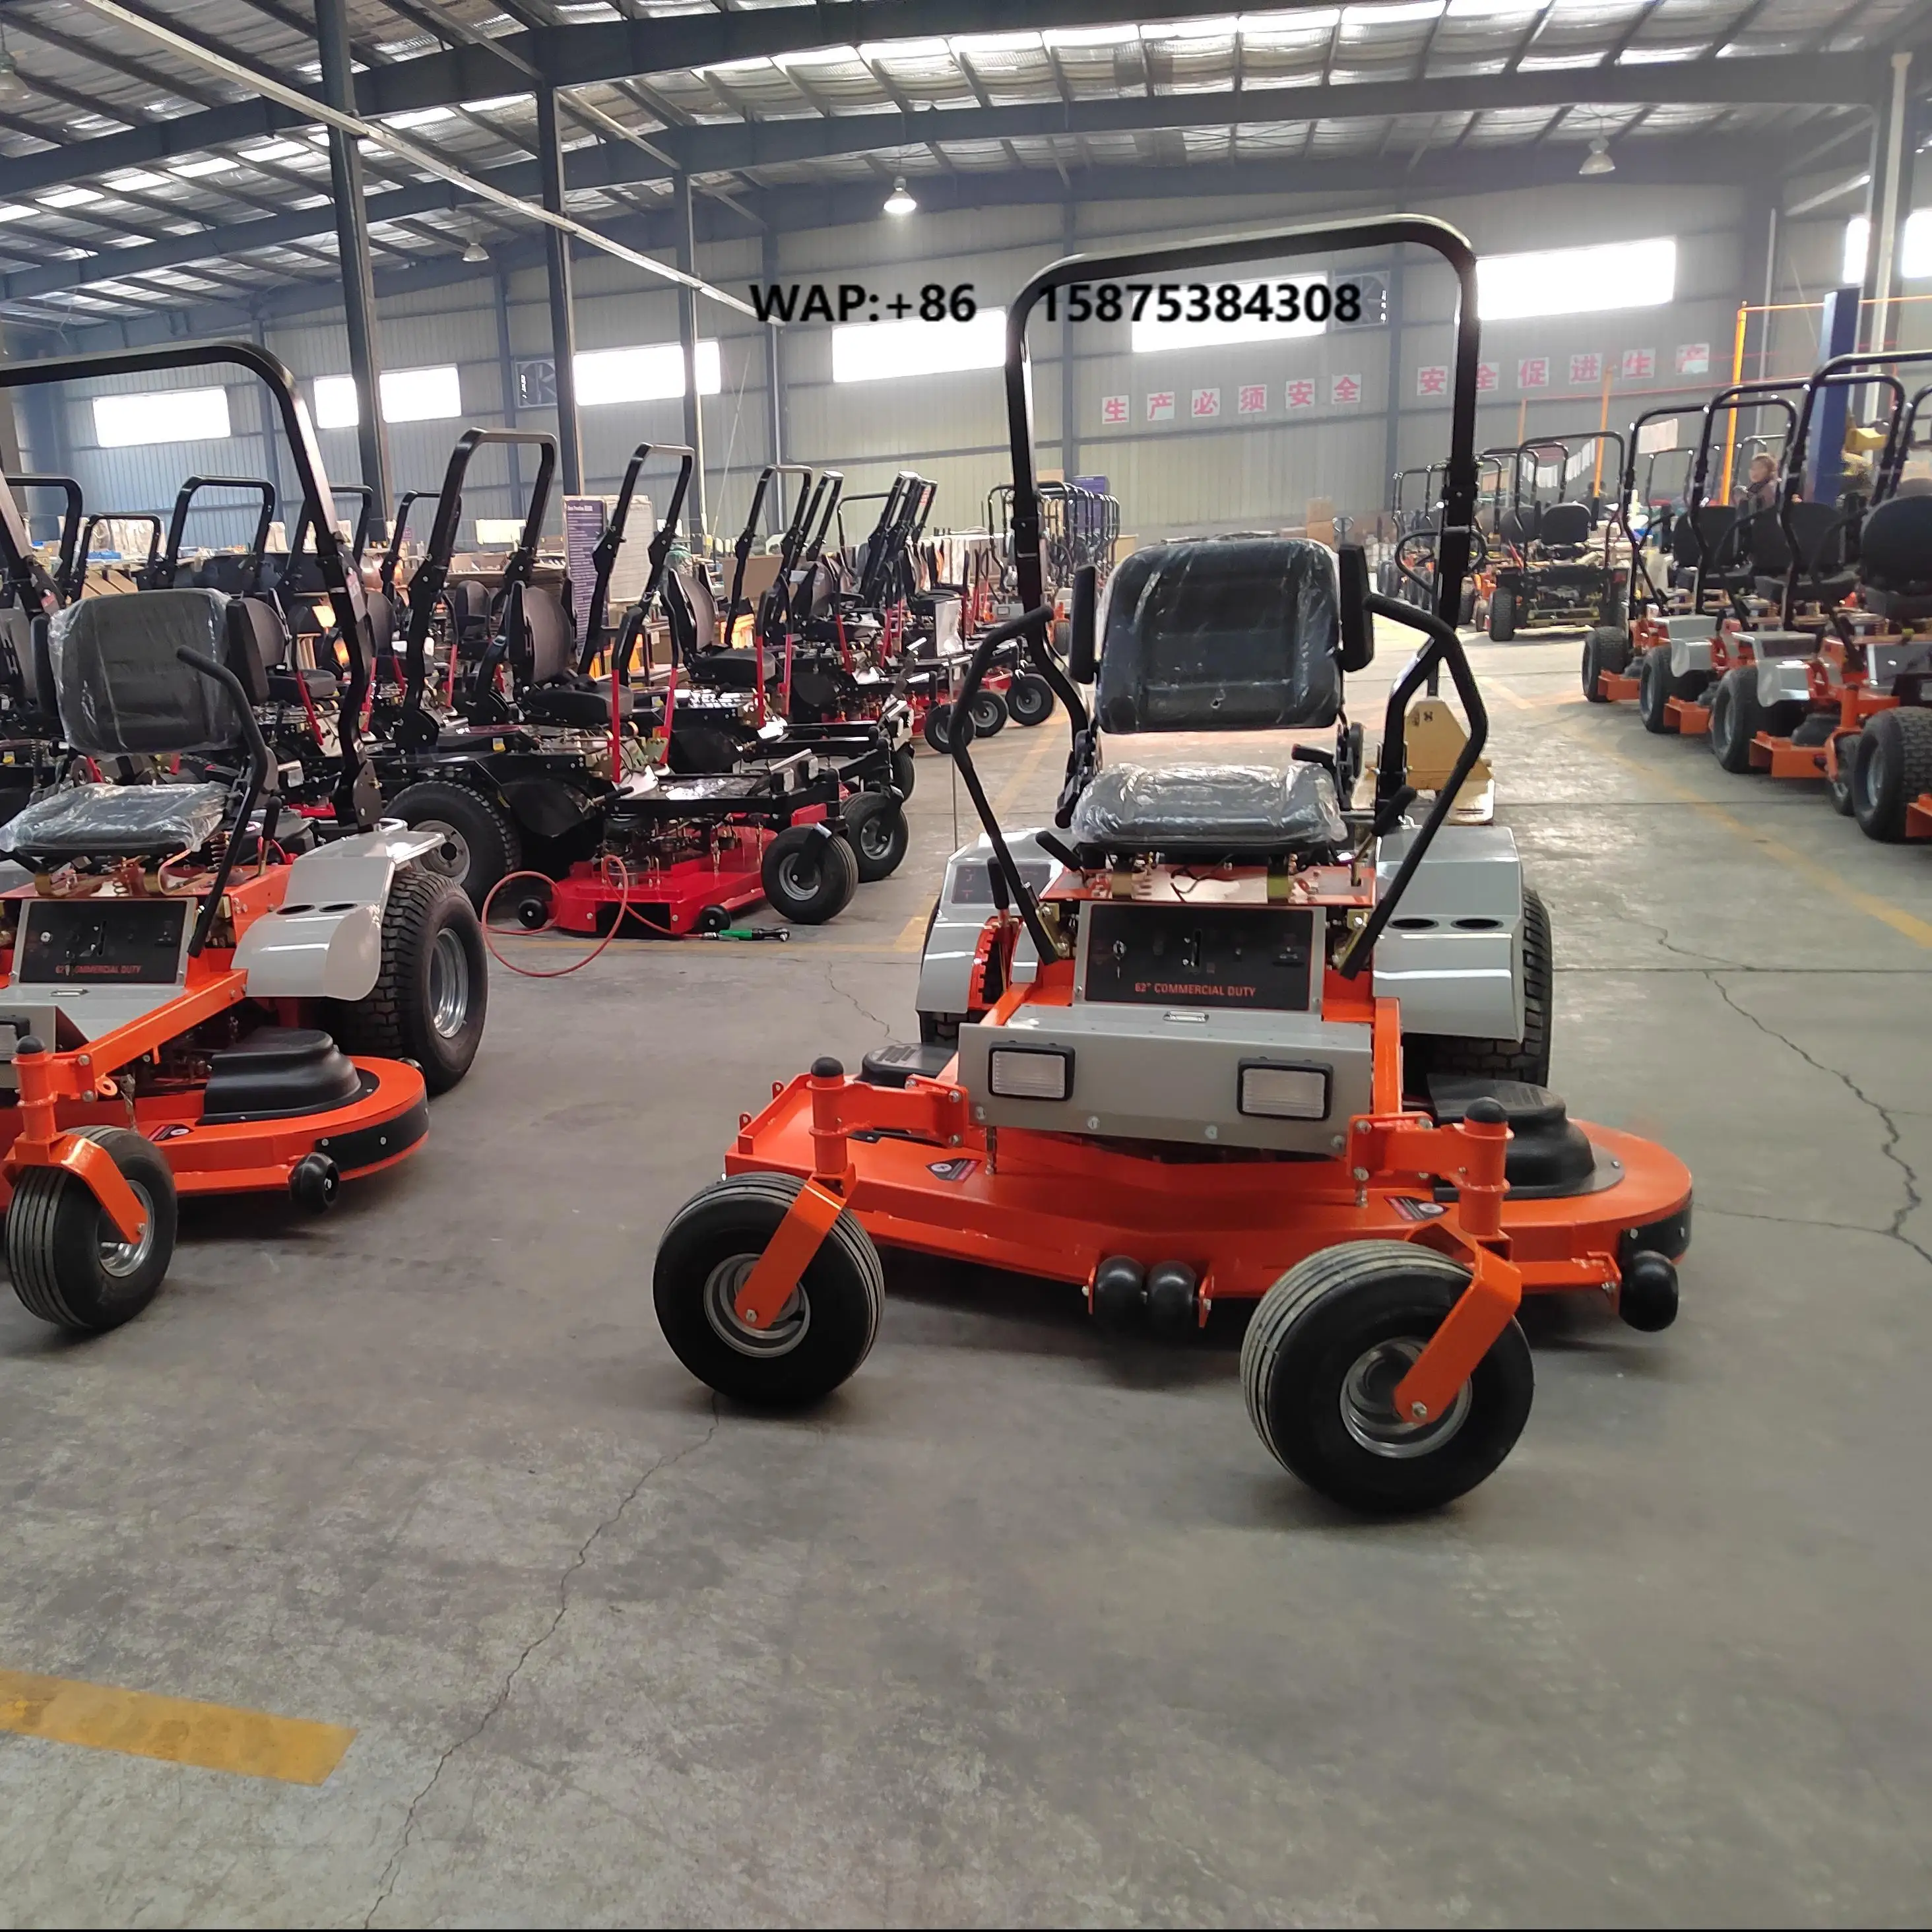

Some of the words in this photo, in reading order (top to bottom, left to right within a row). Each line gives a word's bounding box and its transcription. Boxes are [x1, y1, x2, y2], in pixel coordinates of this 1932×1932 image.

[1104, 375, 1360, 422] 生产必须安全
[1155, 982, 1224, 996] COMMERCIAL
[1227, 986, 1256, 997] DUTY
